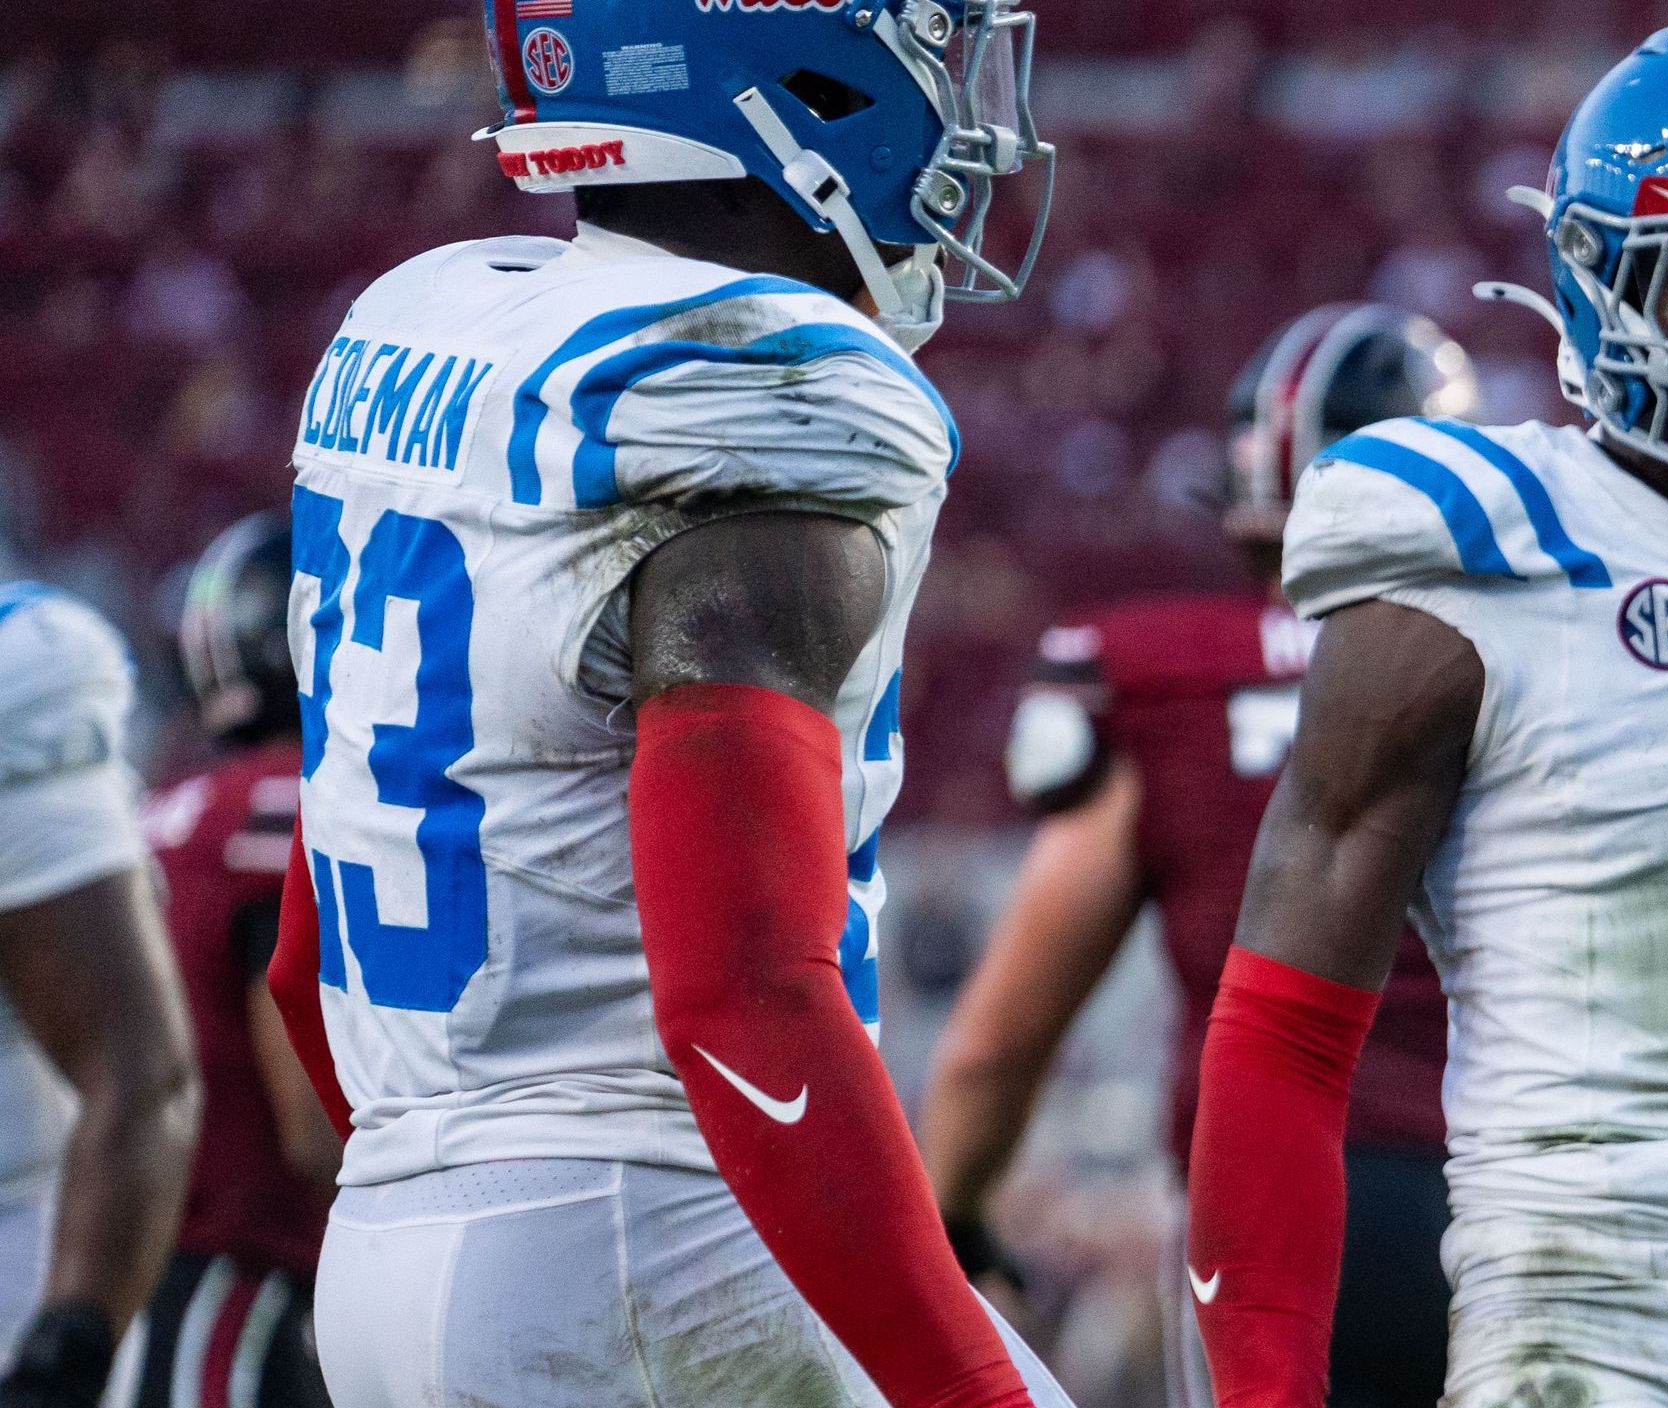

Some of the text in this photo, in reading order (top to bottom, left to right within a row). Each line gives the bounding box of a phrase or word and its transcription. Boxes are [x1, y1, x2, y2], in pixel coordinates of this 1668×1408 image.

[527, 33, 571, 88] SEC
[529, 139, 626, 176] TODDY
[303, 336, 494, 472] COLEMAN
